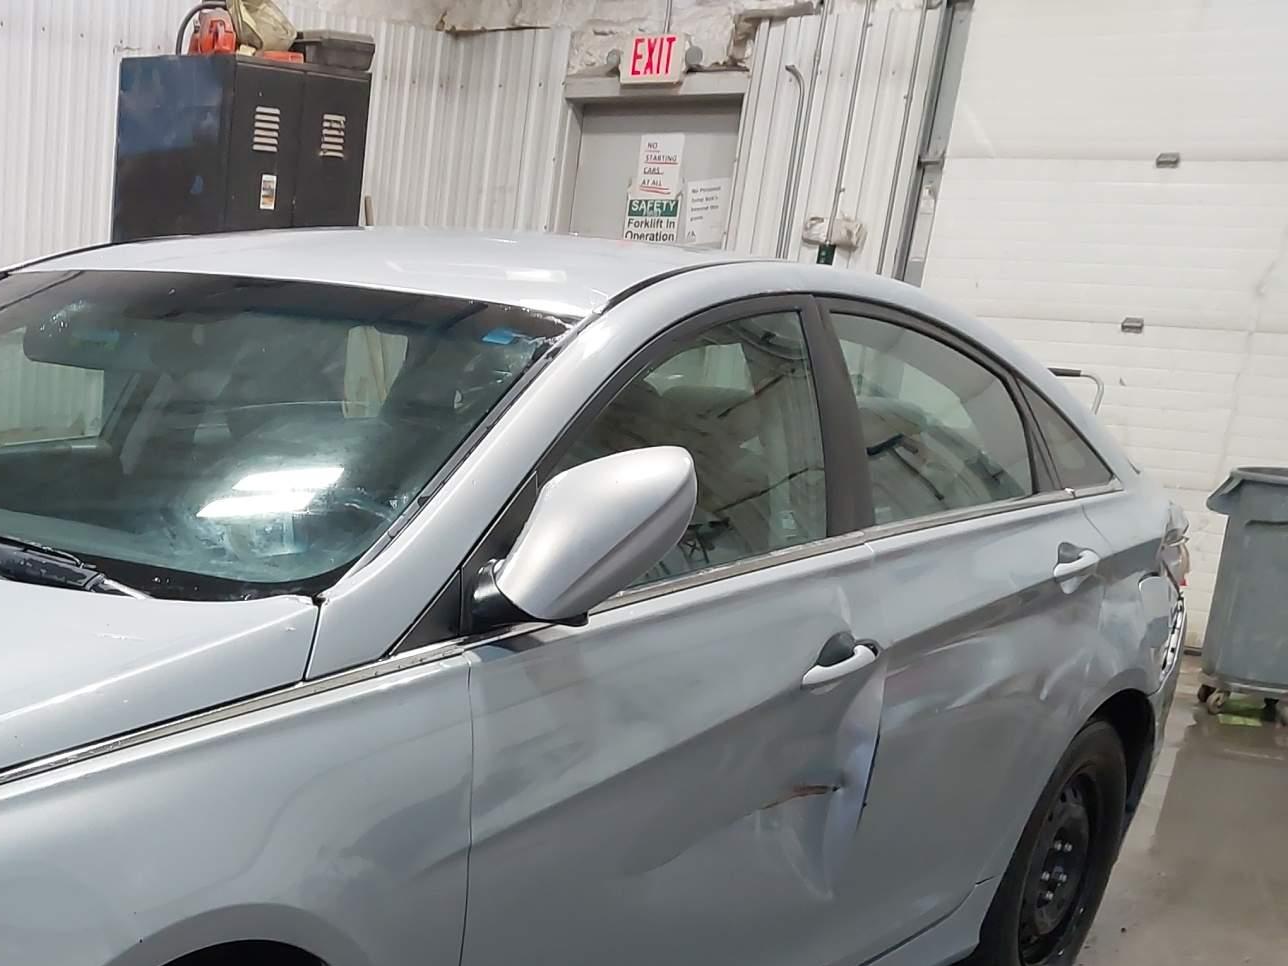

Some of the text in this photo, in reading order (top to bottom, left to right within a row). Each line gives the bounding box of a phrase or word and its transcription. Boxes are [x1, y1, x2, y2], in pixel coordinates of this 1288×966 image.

[631, 36, 677, 76] EXIT
[645, 154, 678, 162] STARTING
[631, 199, 676, 211] SAFETY
[627, 218, 676, 229] Forklift In
